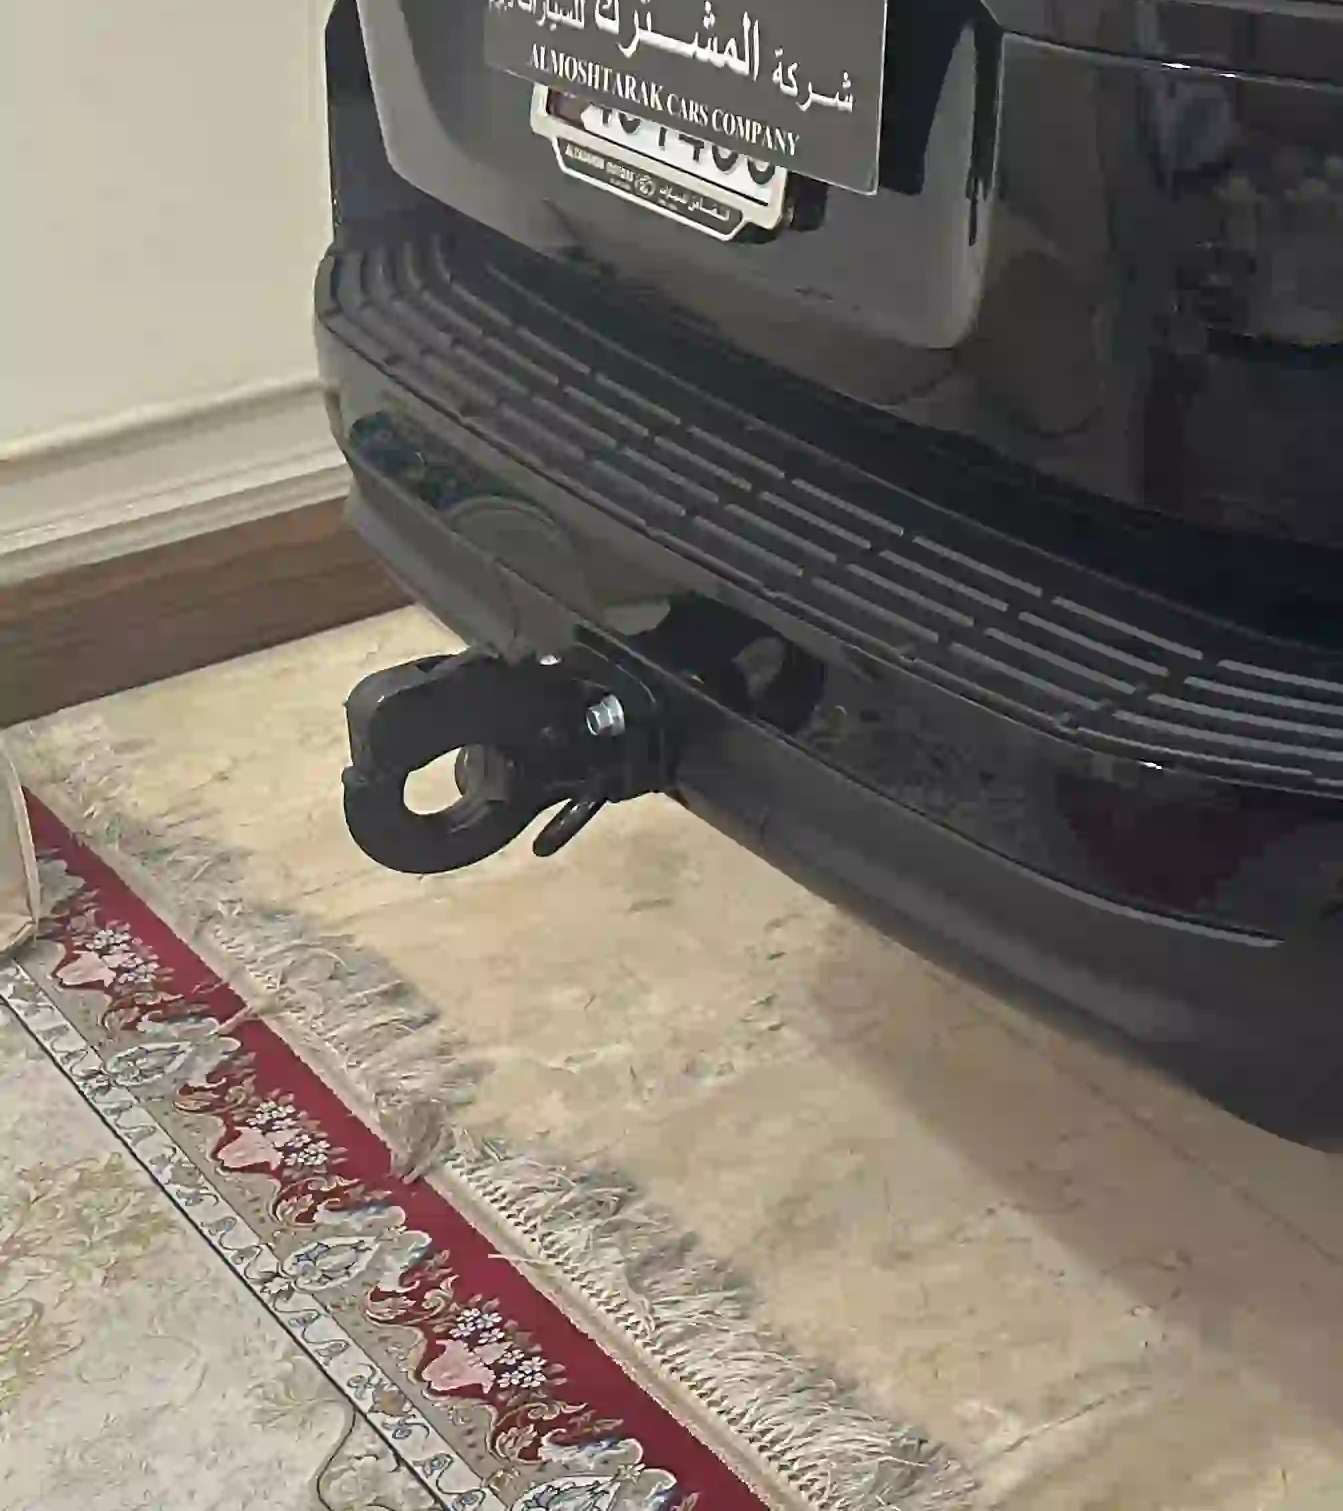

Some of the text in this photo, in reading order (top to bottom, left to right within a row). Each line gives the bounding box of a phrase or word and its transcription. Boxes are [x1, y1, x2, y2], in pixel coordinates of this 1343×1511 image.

[772, 46, 854, 112] شركة
[666, 93, 709, 127] CARS
[712, 108, 800, 156] COMPANY
